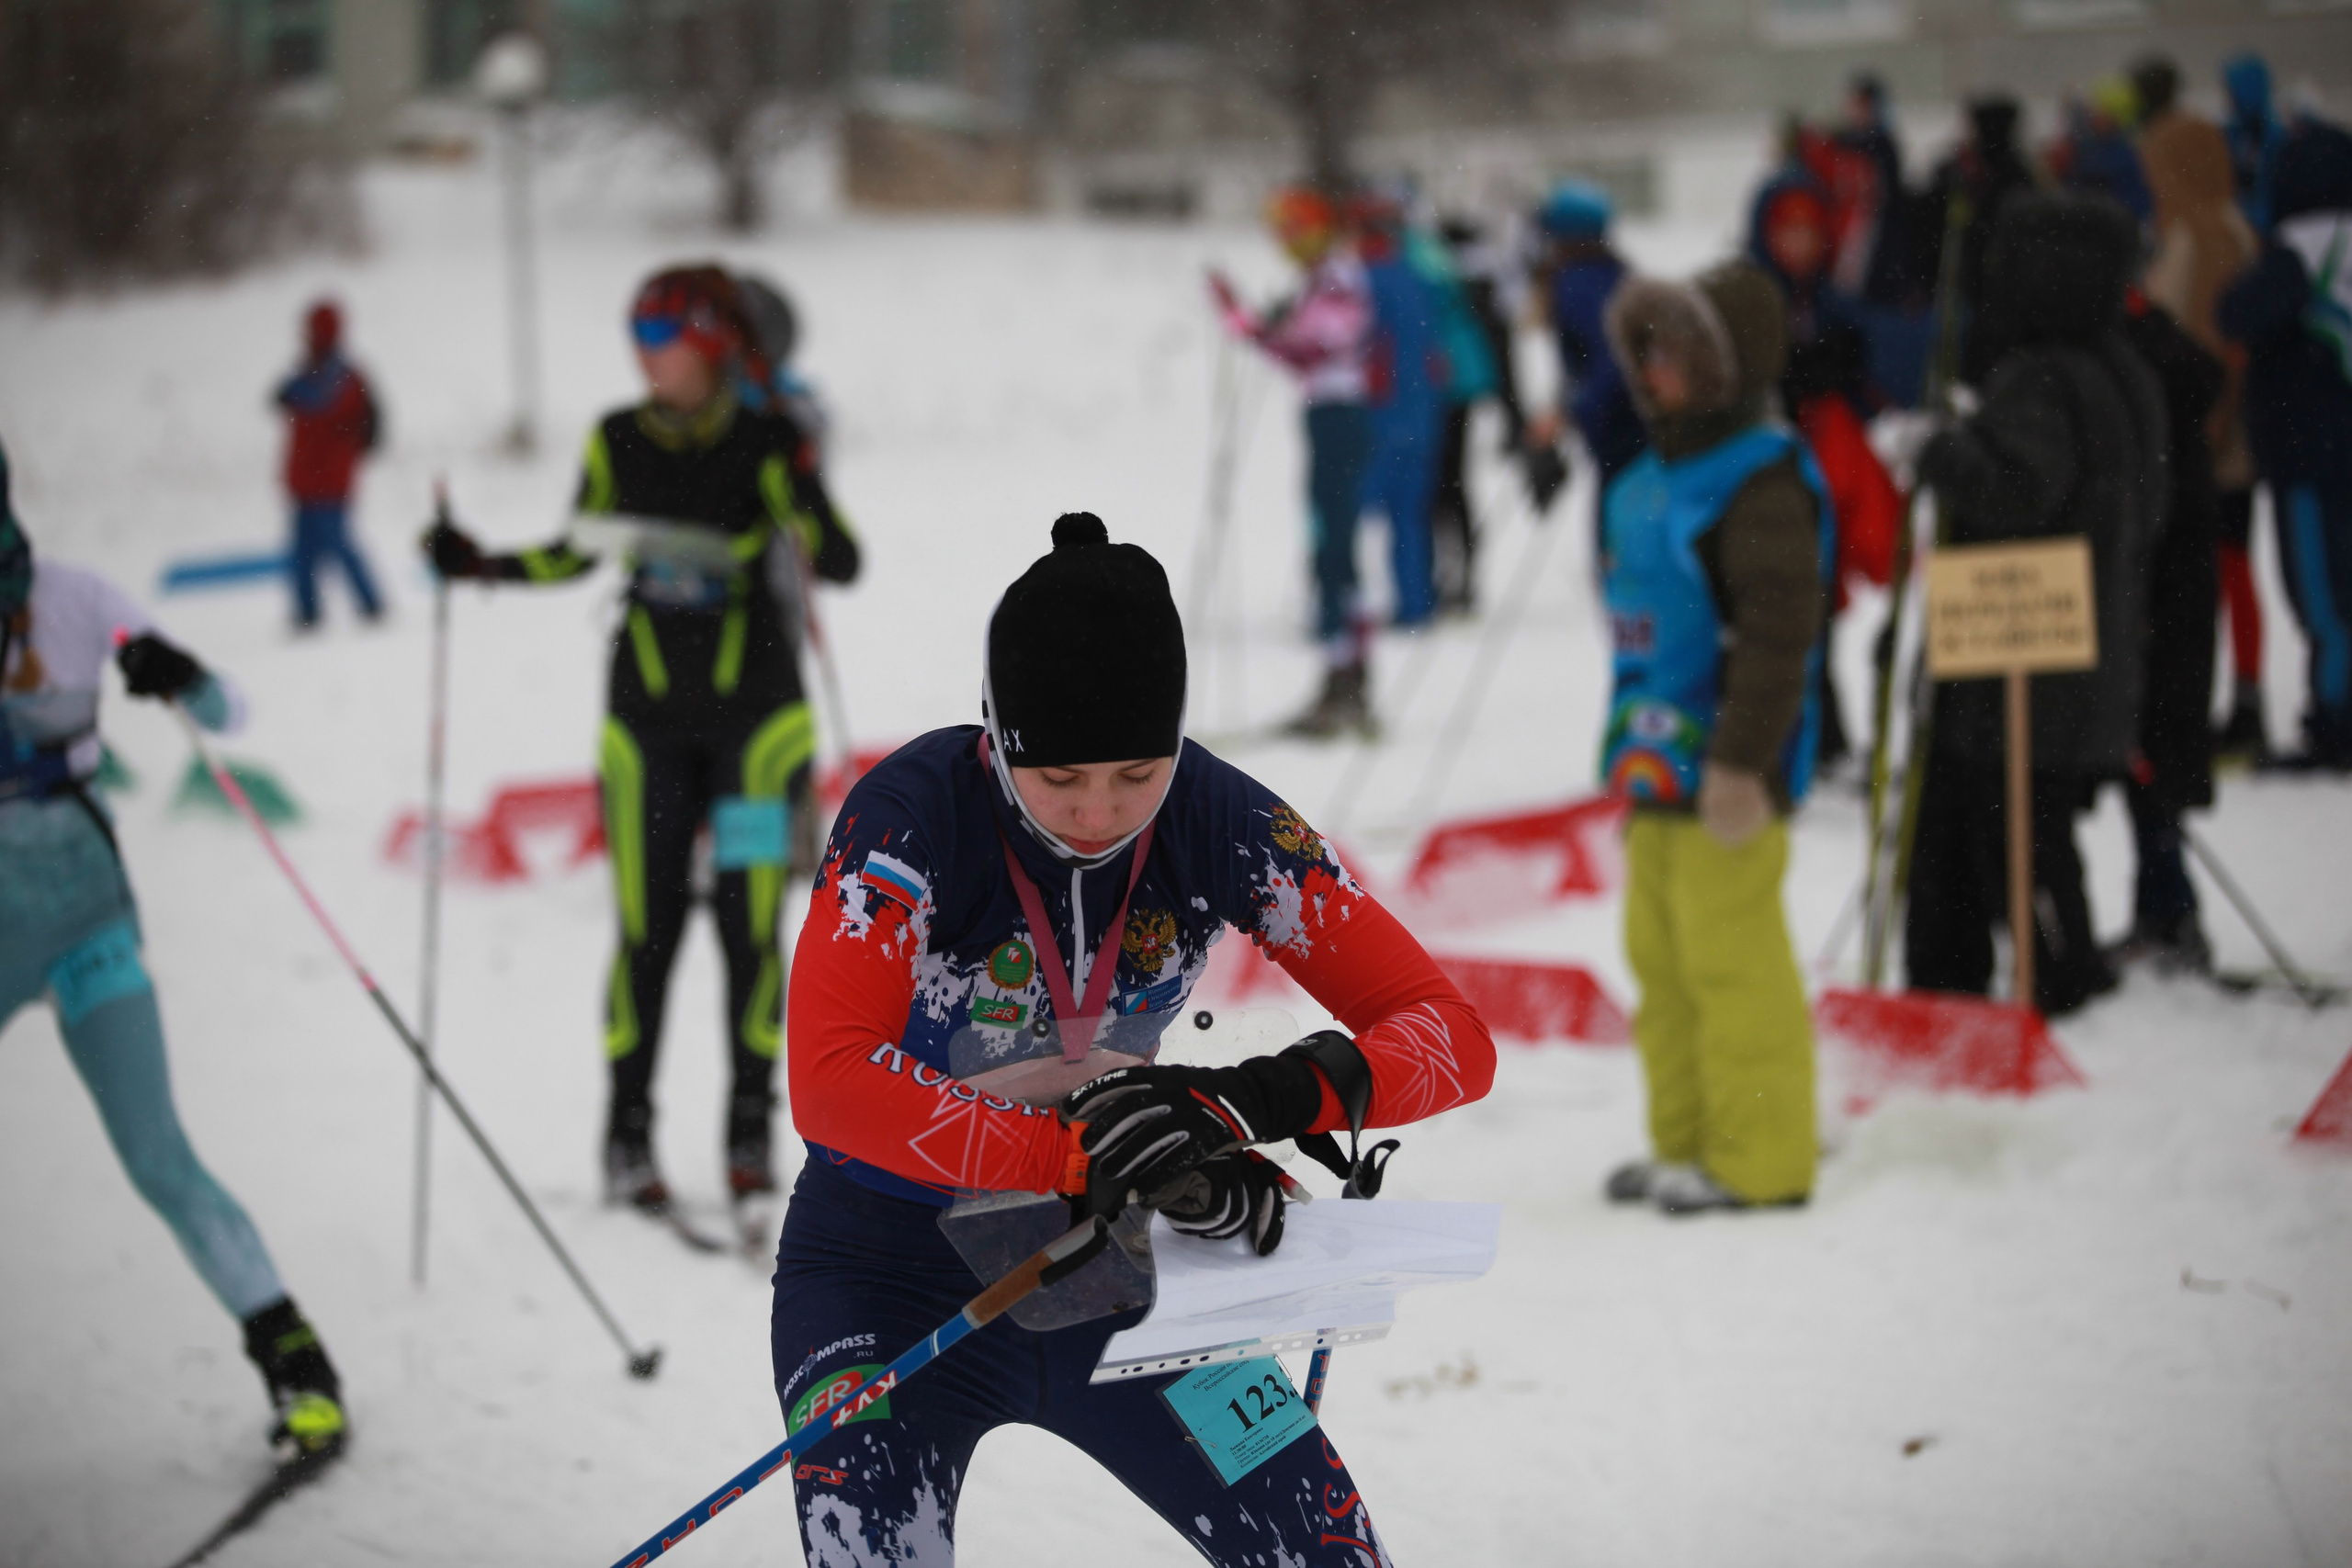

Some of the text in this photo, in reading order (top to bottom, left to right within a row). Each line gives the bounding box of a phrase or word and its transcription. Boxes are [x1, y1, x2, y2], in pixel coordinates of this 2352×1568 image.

[981, 1004, 1014, 1020] SFR
[1071, 1069, 1128, 1101] SKI TIME
[1193, 1378, 1209, 1390] Кубок
[1208, 1365, 1227, 1379] России
